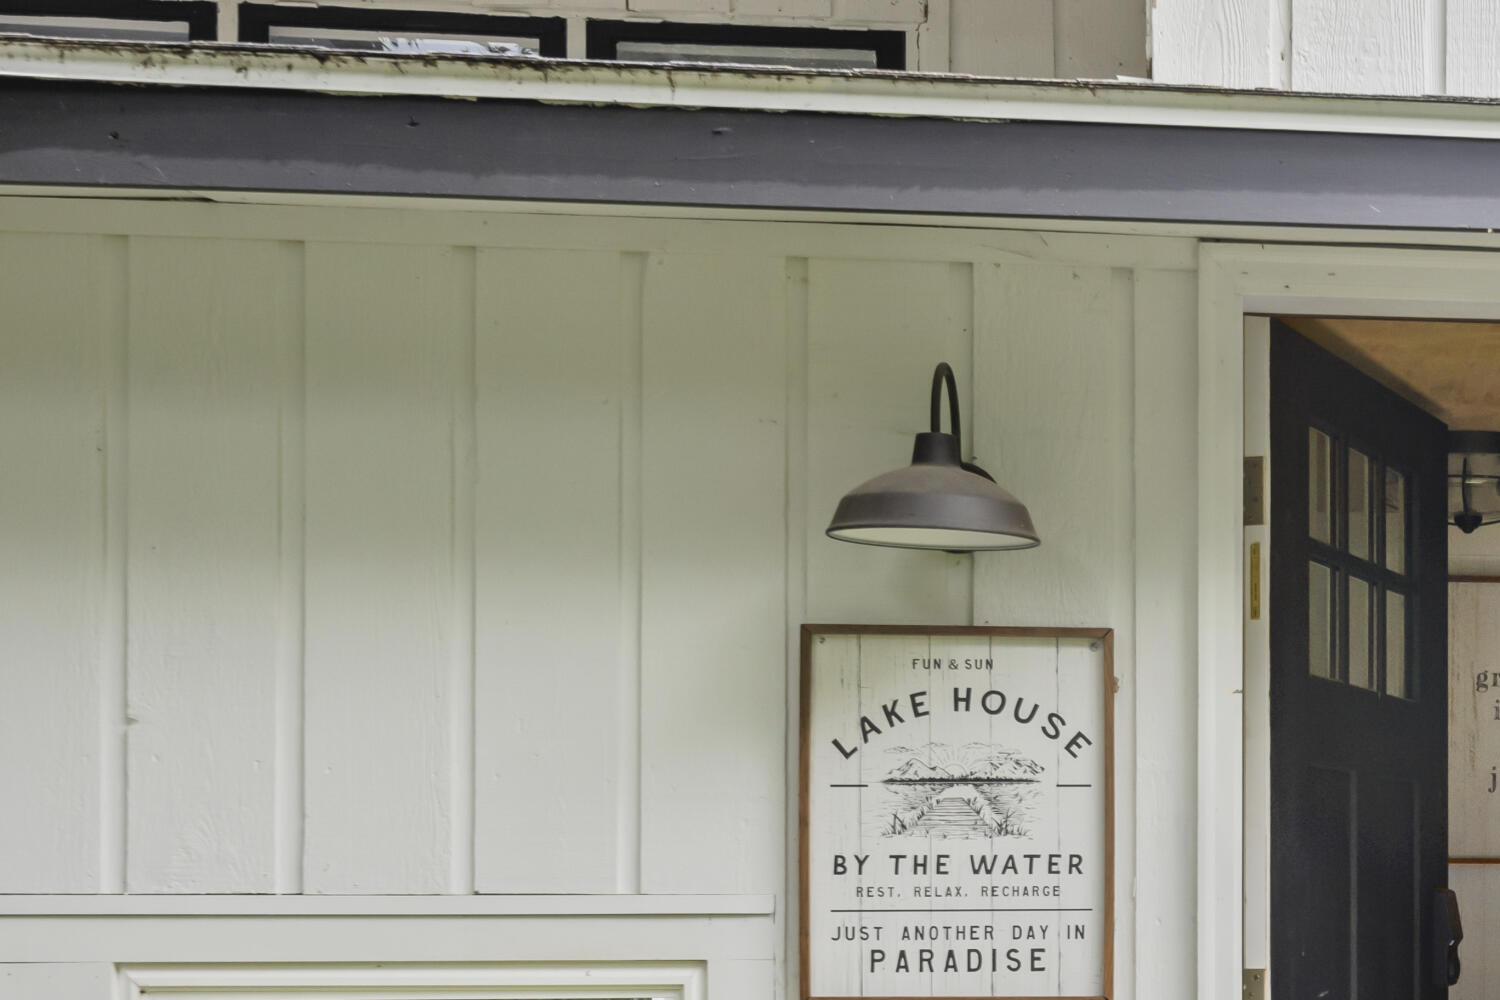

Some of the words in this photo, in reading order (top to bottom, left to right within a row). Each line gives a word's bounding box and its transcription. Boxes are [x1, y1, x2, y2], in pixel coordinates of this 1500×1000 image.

[912, 658, 941, 670] FUN
[949, 658, 958, 670] &
[965, 658, 994, 670] SUN
[831, 691, 930, 760] LAKE
[953, 687, 1093, 759] HOUSE
[833, 855, 870, 875] BY
[889, 855, 950, 875] THE
[970, 854, 1084, 875] WATER
[856, 886, 901, 898] REST.
[914, 886, 968, 898] RELAX.
[981, 885, 1061, 897] RECHARGE
[831, 926, 883, 941] JUST
[902, 926, 994, 941] ANOTHER
[1012, 925, 1049, 940] DAY
[1067, 925, 1085, 940] IN
[870, 948, 1046, 973] PARADISE
